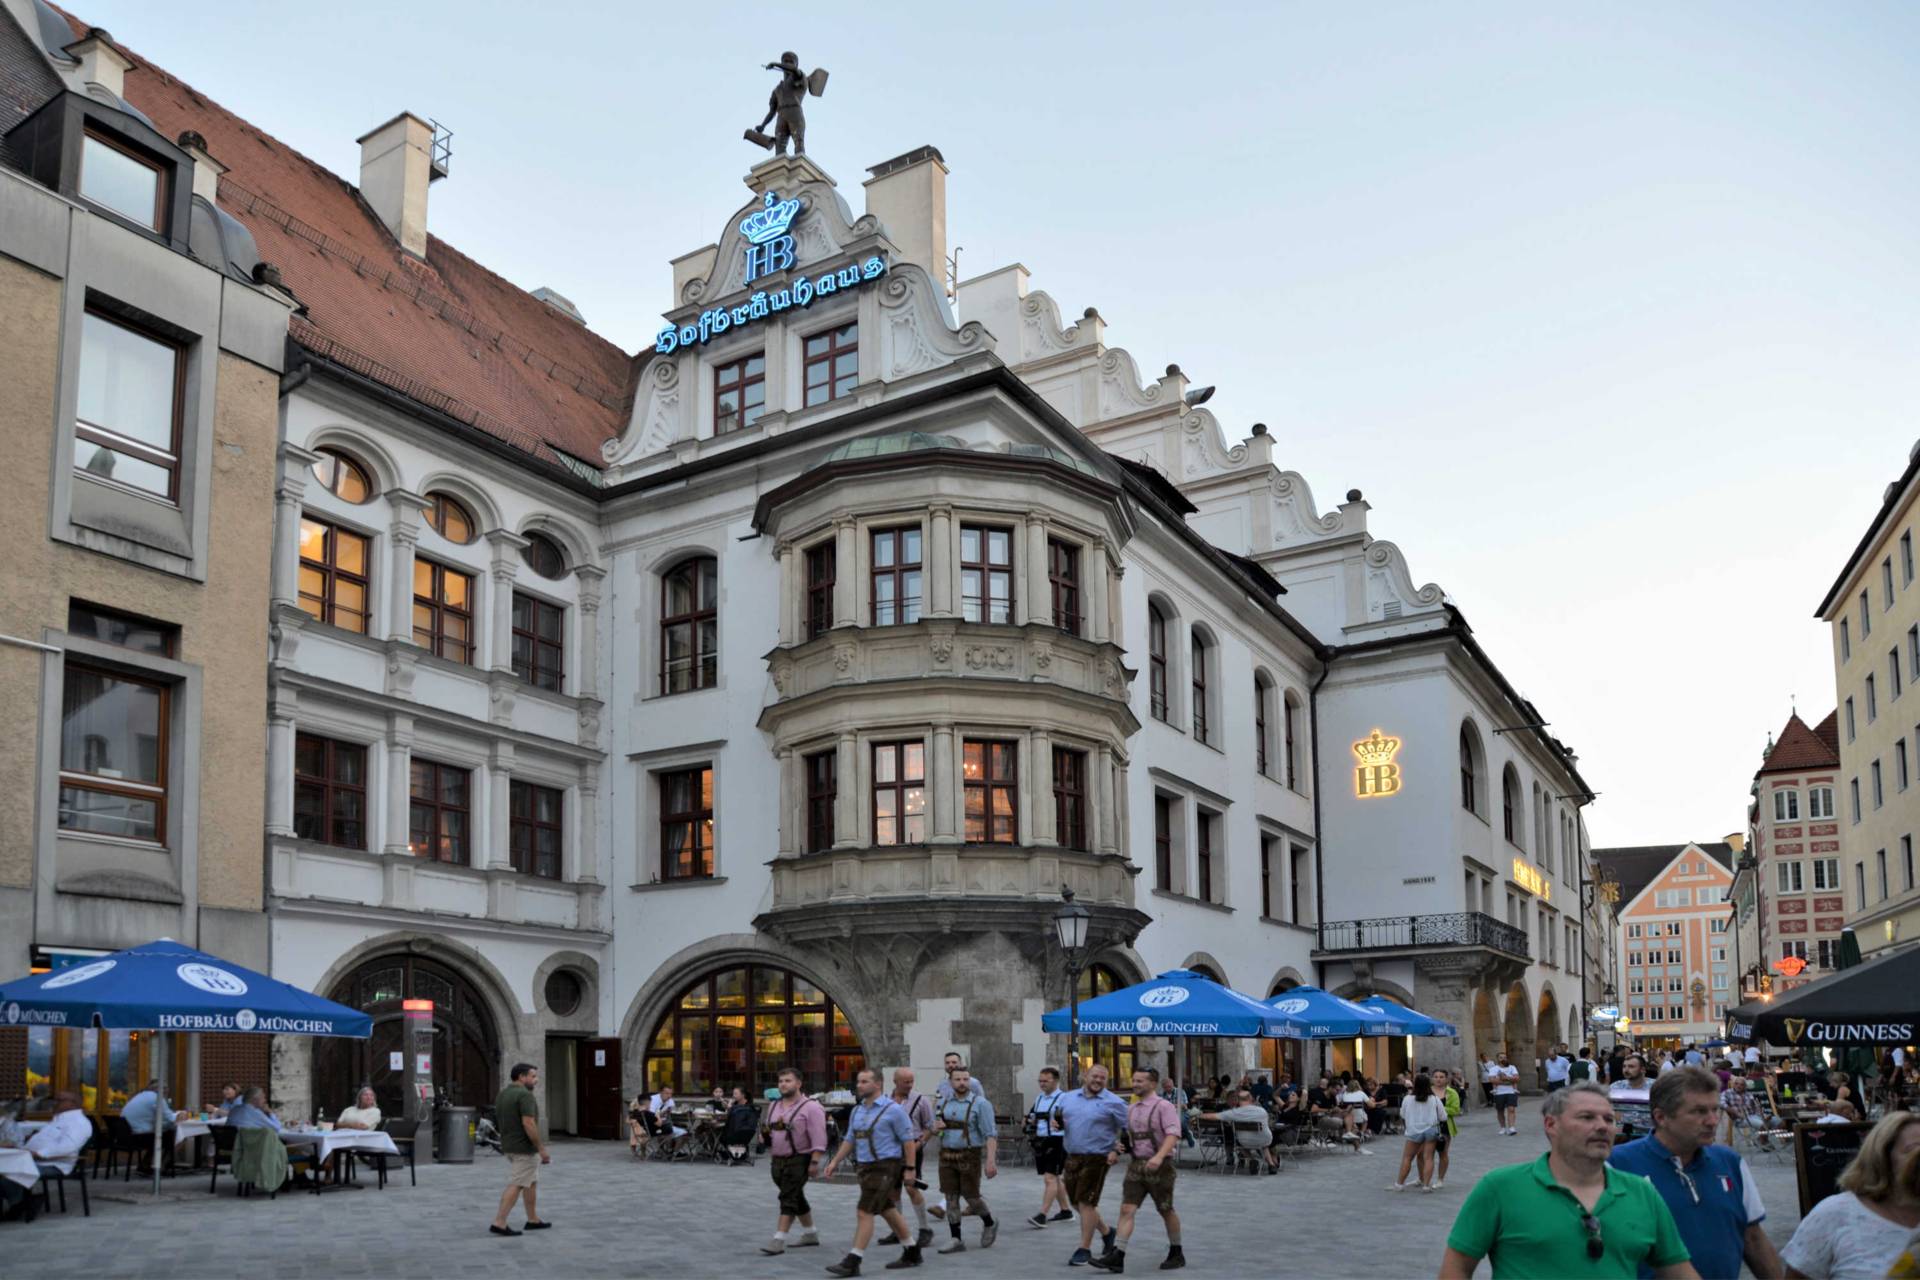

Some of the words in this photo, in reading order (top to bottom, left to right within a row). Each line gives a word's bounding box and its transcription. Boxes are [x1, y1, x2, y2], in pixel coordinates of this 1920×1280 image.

[744, 235, 794, 285] HB
[656, 256, 885, 353] Hofbräuhaus
[1356, 764, 1399, 795] HB
[20, 1009, 68, 1024] MÜNCHEN
[159, 1014, 234, 1028] HOFBRÄU
[258, 1016, 333, 1032] MÜNCHEN
[1079, 1021, 1134, 1032] HOFBRÄU
[1153, 1021, 1219, 1033] MÜNCHEN
[1806, 1022, 1912, 1040] GUINNESS
